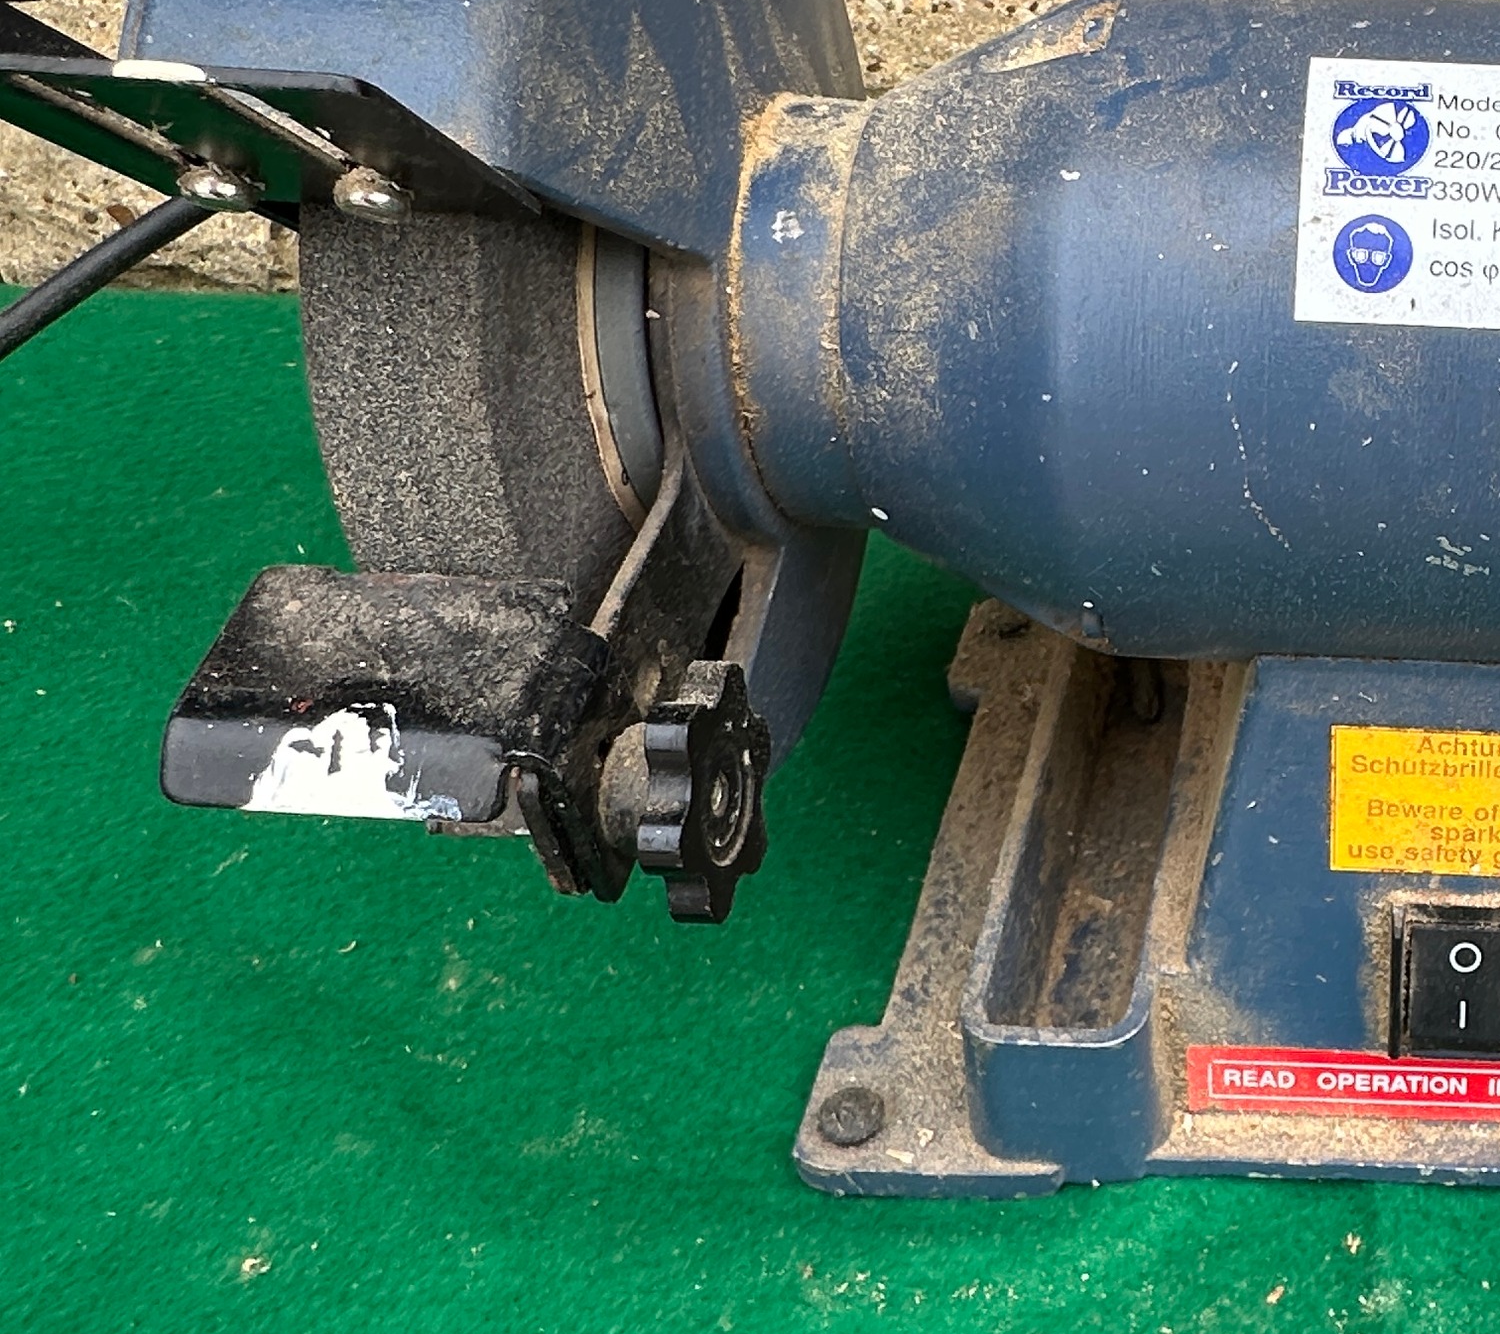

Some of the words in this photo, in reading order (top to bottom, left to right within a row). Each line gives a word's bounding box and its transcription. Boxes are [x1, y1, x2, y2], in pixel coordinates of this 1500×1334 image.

[1335, 81, 1431, 99] Record
[1328, 170, 1433, 196] Power
[1432, 218, 1481, 241] Isol.
[1429, 260, 1473, 278] cos
[1367, 799, 1463, 820] Beware
[1474, 804, 1499, 822] of
[1348, 844, 1394, 860] use
[1405, 845, 1482, 866] safety
[1223, 1069, 1296, 1090] READ
[1316, 1071, 1468, 1096] OPERATION
